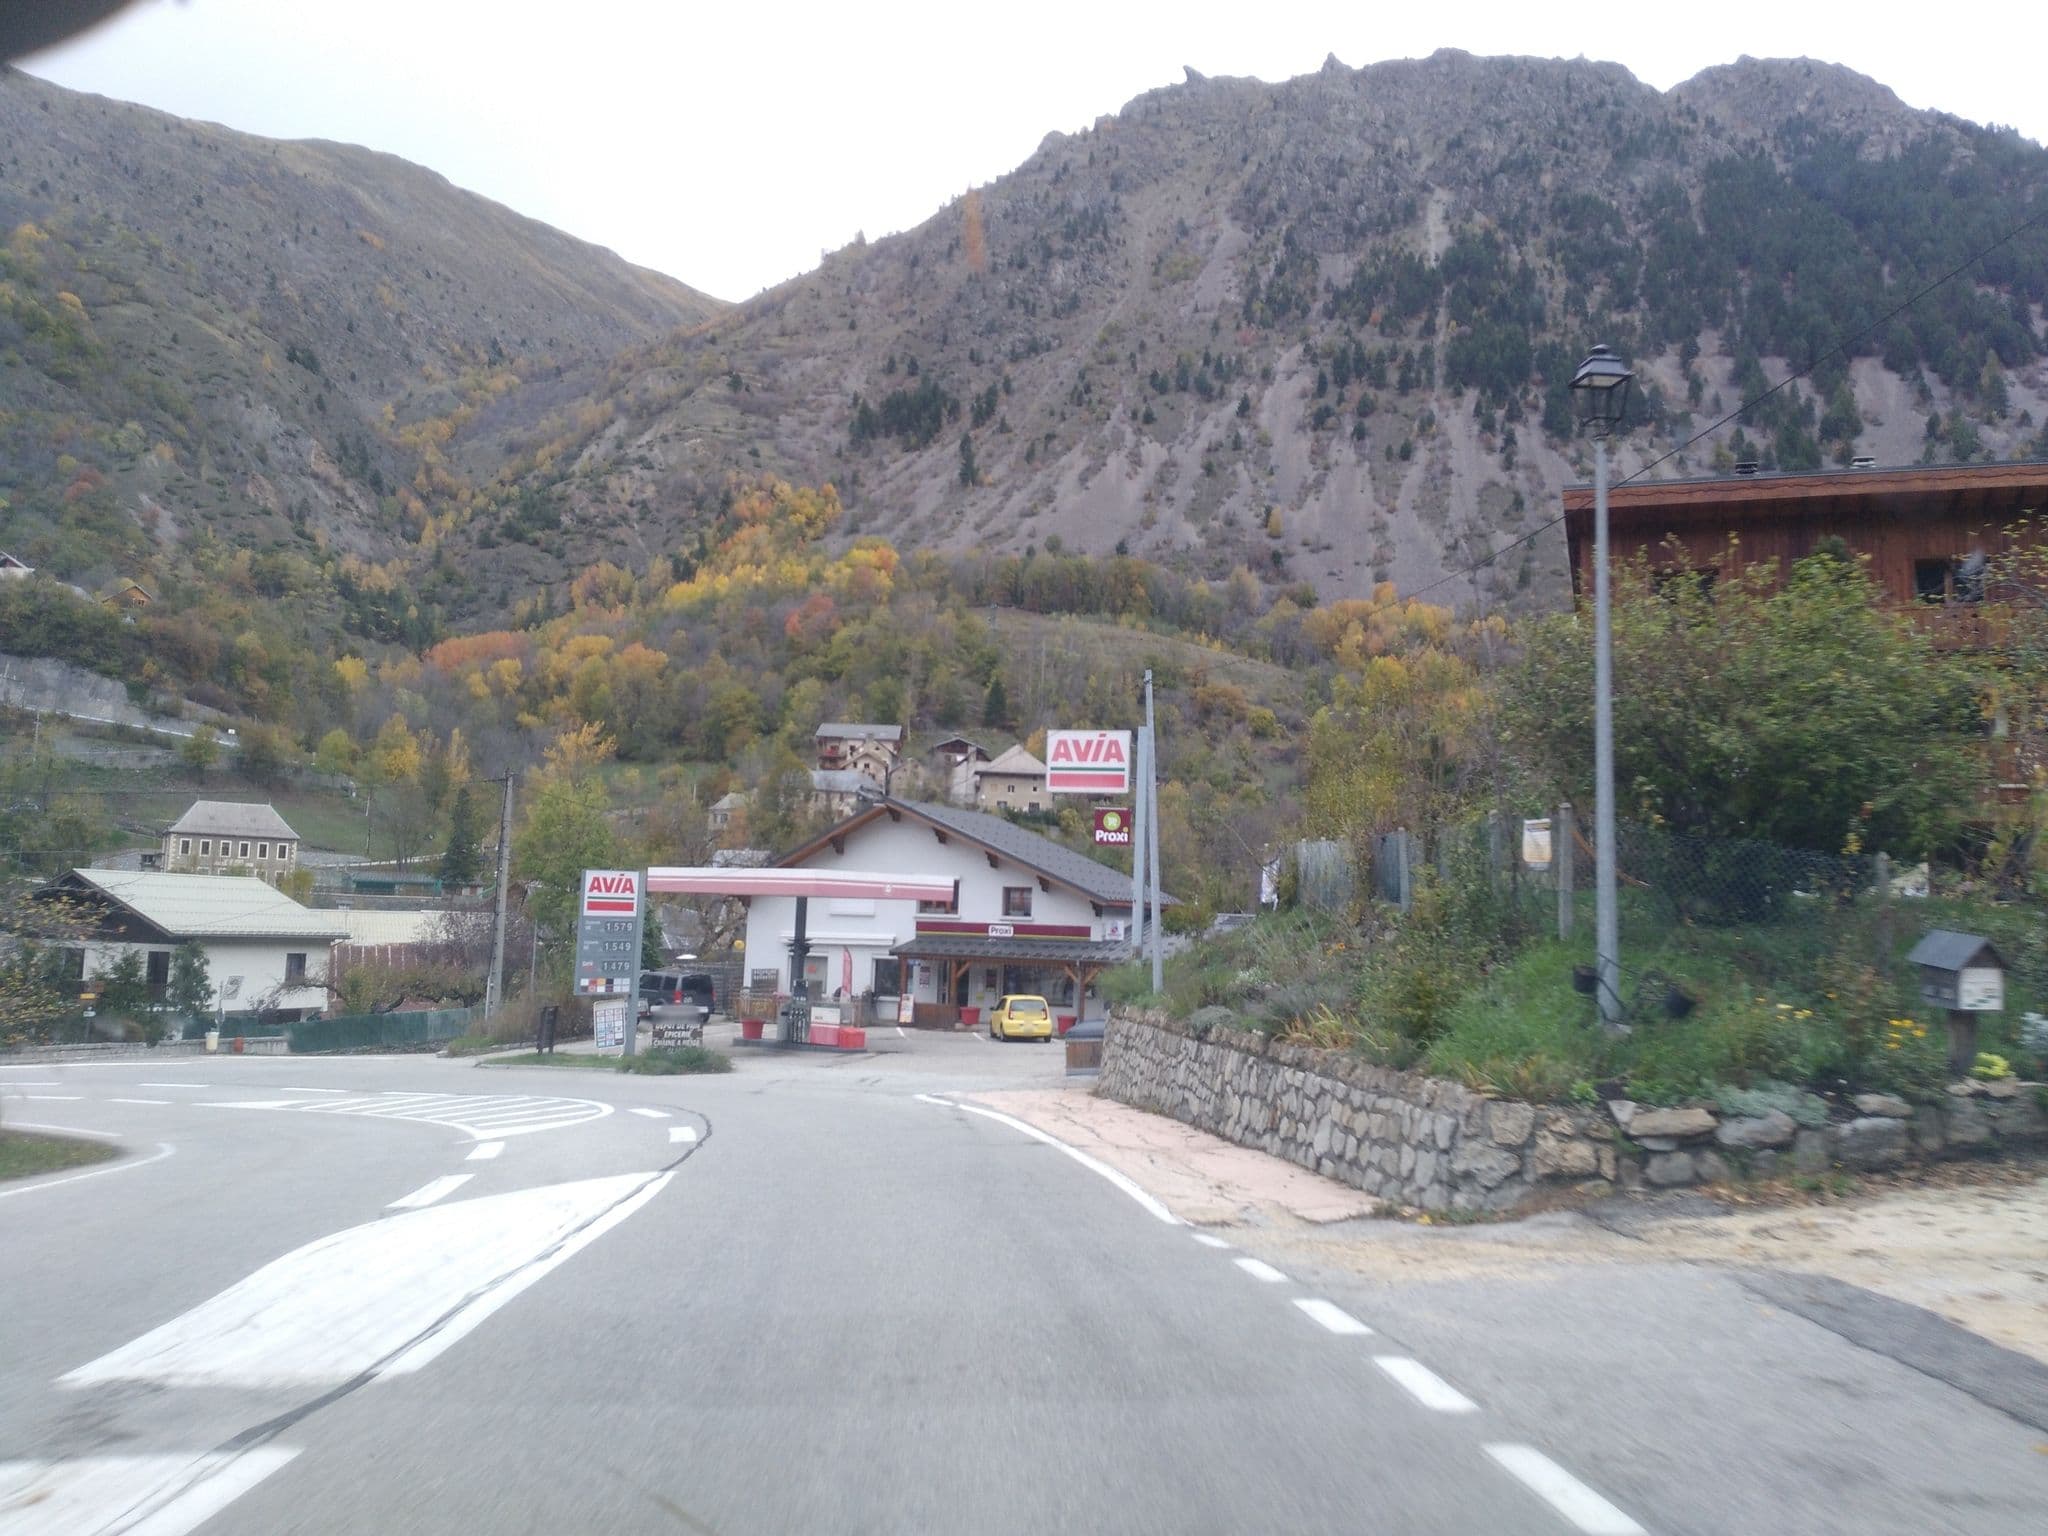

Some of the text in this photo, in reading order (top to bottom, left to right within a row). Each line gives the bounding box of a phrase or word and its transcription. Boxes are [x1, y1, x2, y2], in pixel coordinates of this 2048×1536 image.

[1051, 733, 1126, 763] AVIA
[1095, 826, 1129, 842] Proxi
[588, 873, 635, 894] AVIA
[990, 926, 1012, 935] Proxi
